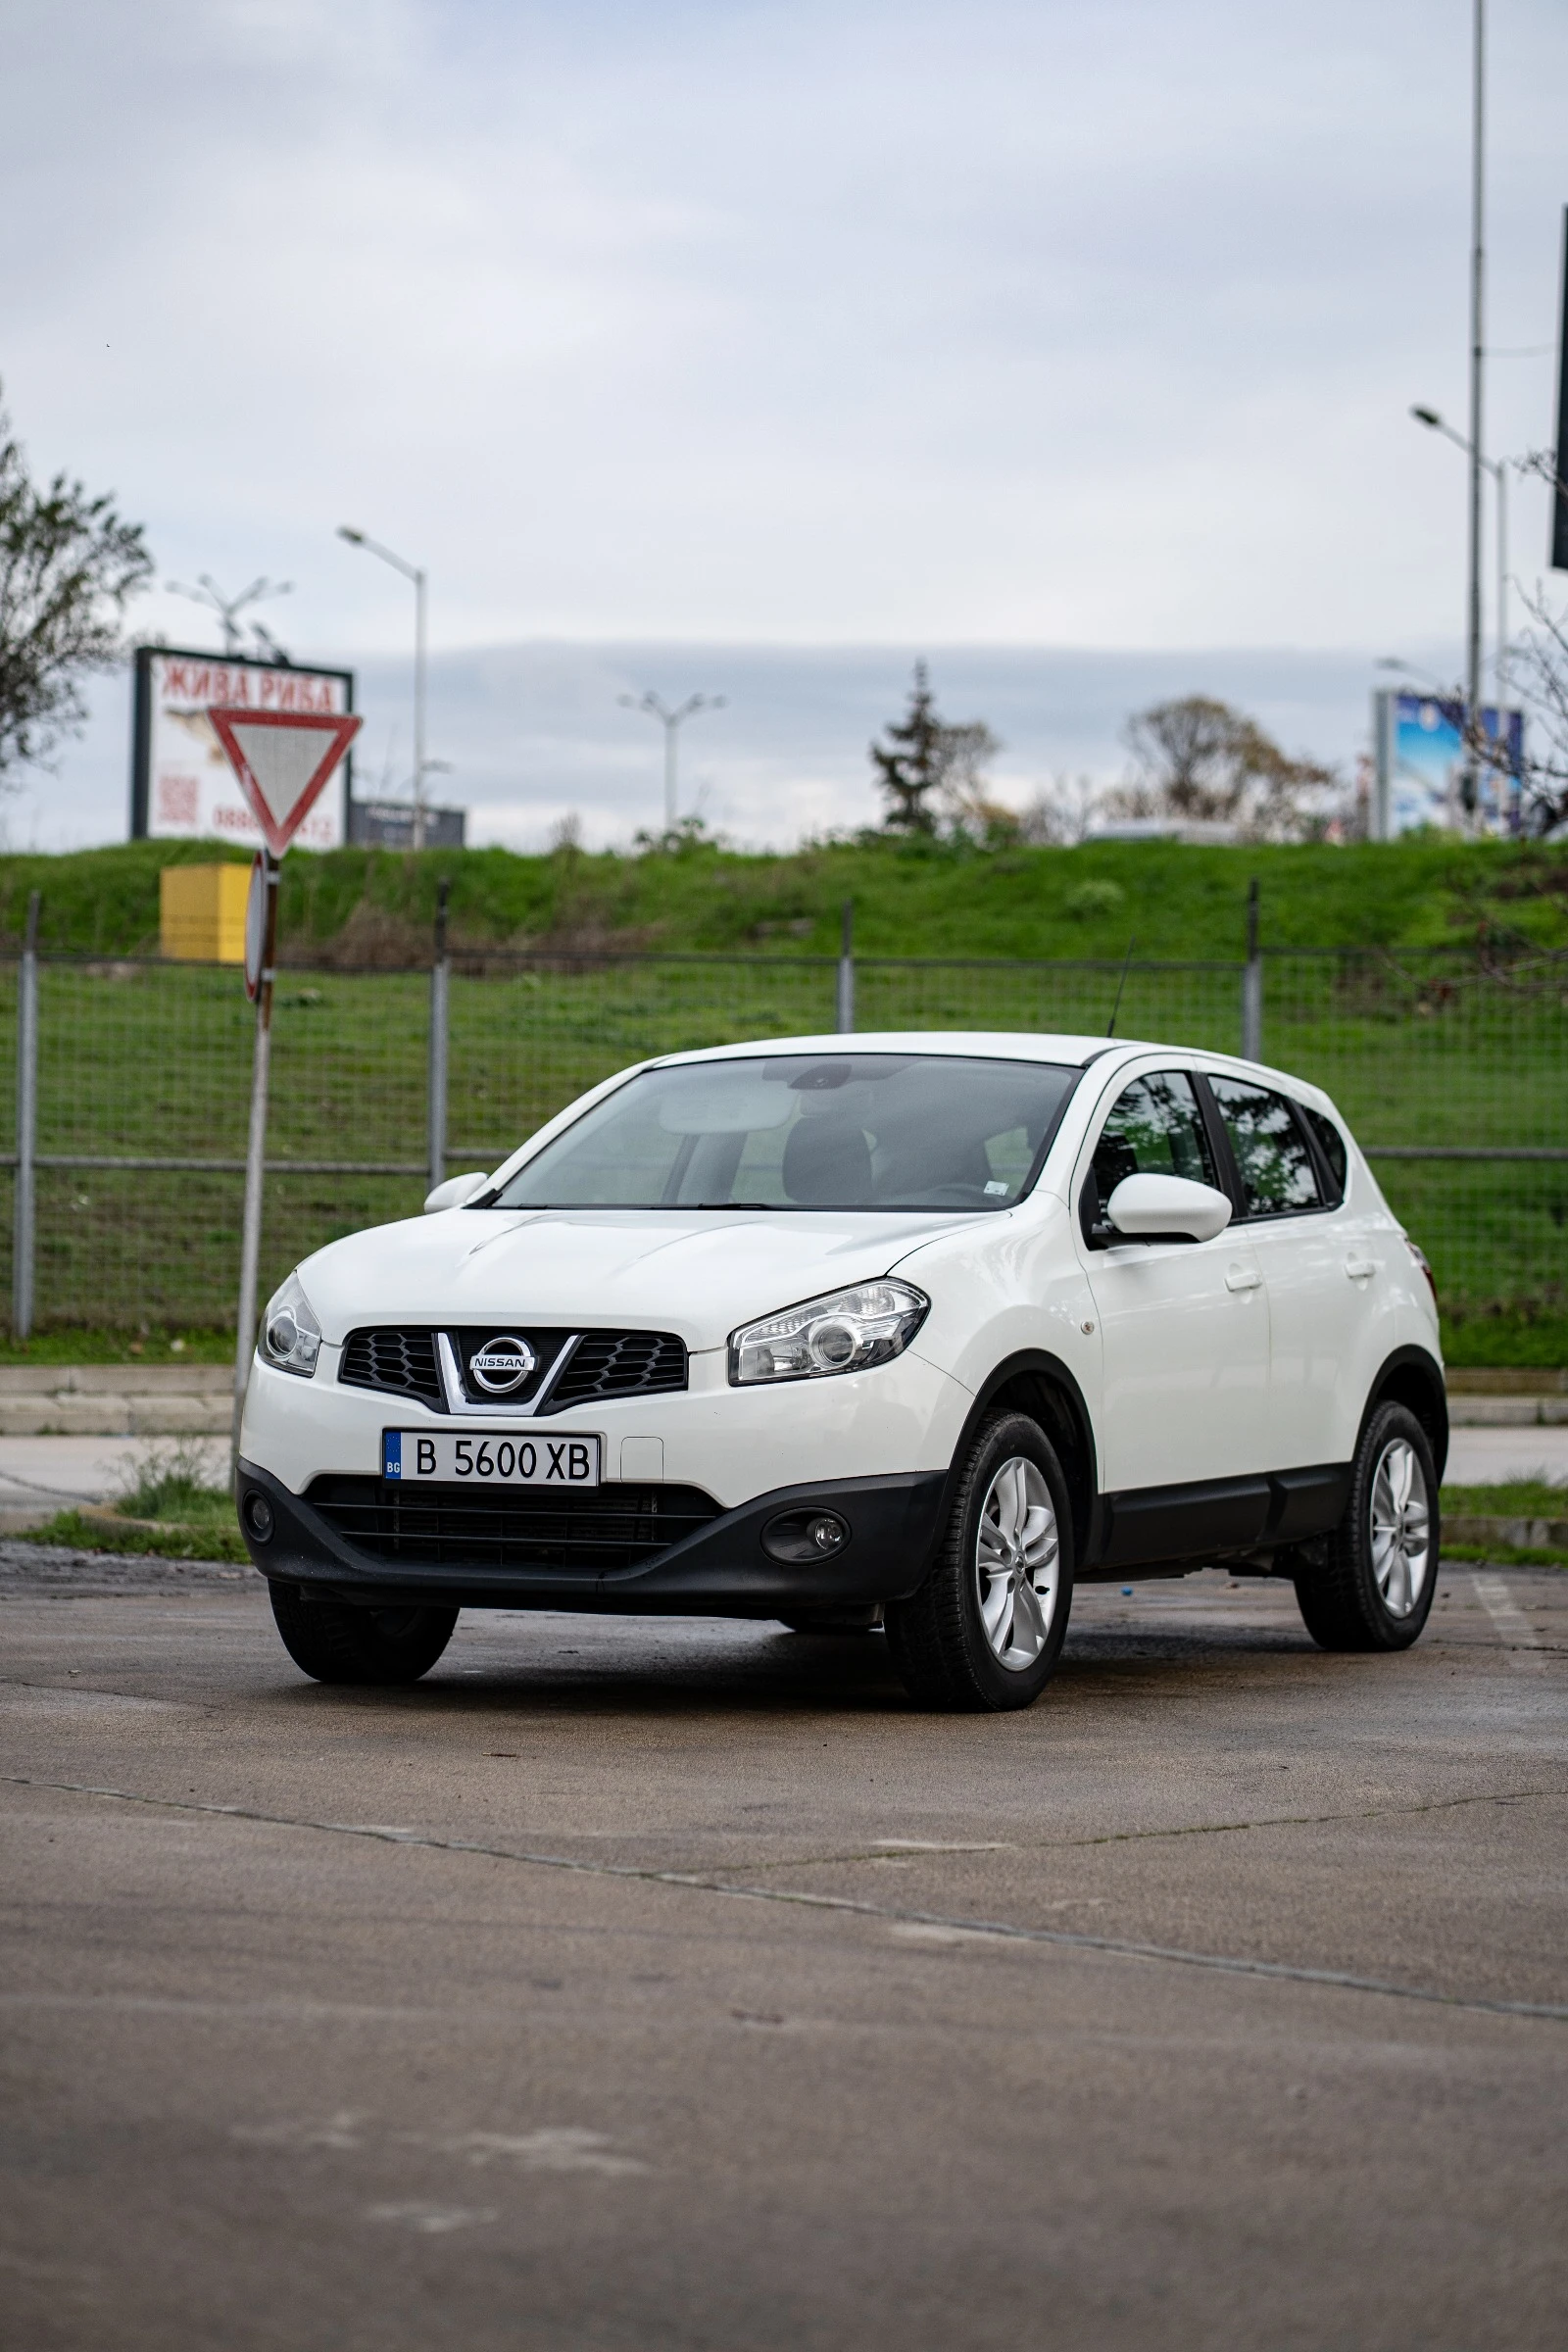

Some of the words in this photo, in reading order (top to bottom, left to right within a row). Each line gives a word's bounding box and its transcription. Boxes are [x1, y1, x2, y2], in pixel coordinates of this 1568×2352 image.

[164, 660, 249, 704] ЖИВА
[260, 669, 333, 714] РИБА
[474, 1357, 526, 1368] NISSAN
[386, 1461, 401, 1474] BG
[416, 1439, 437, 1475] B
[455, 1441, 537, 1478] 5600
[545, 1443, 590, 1480] XB
